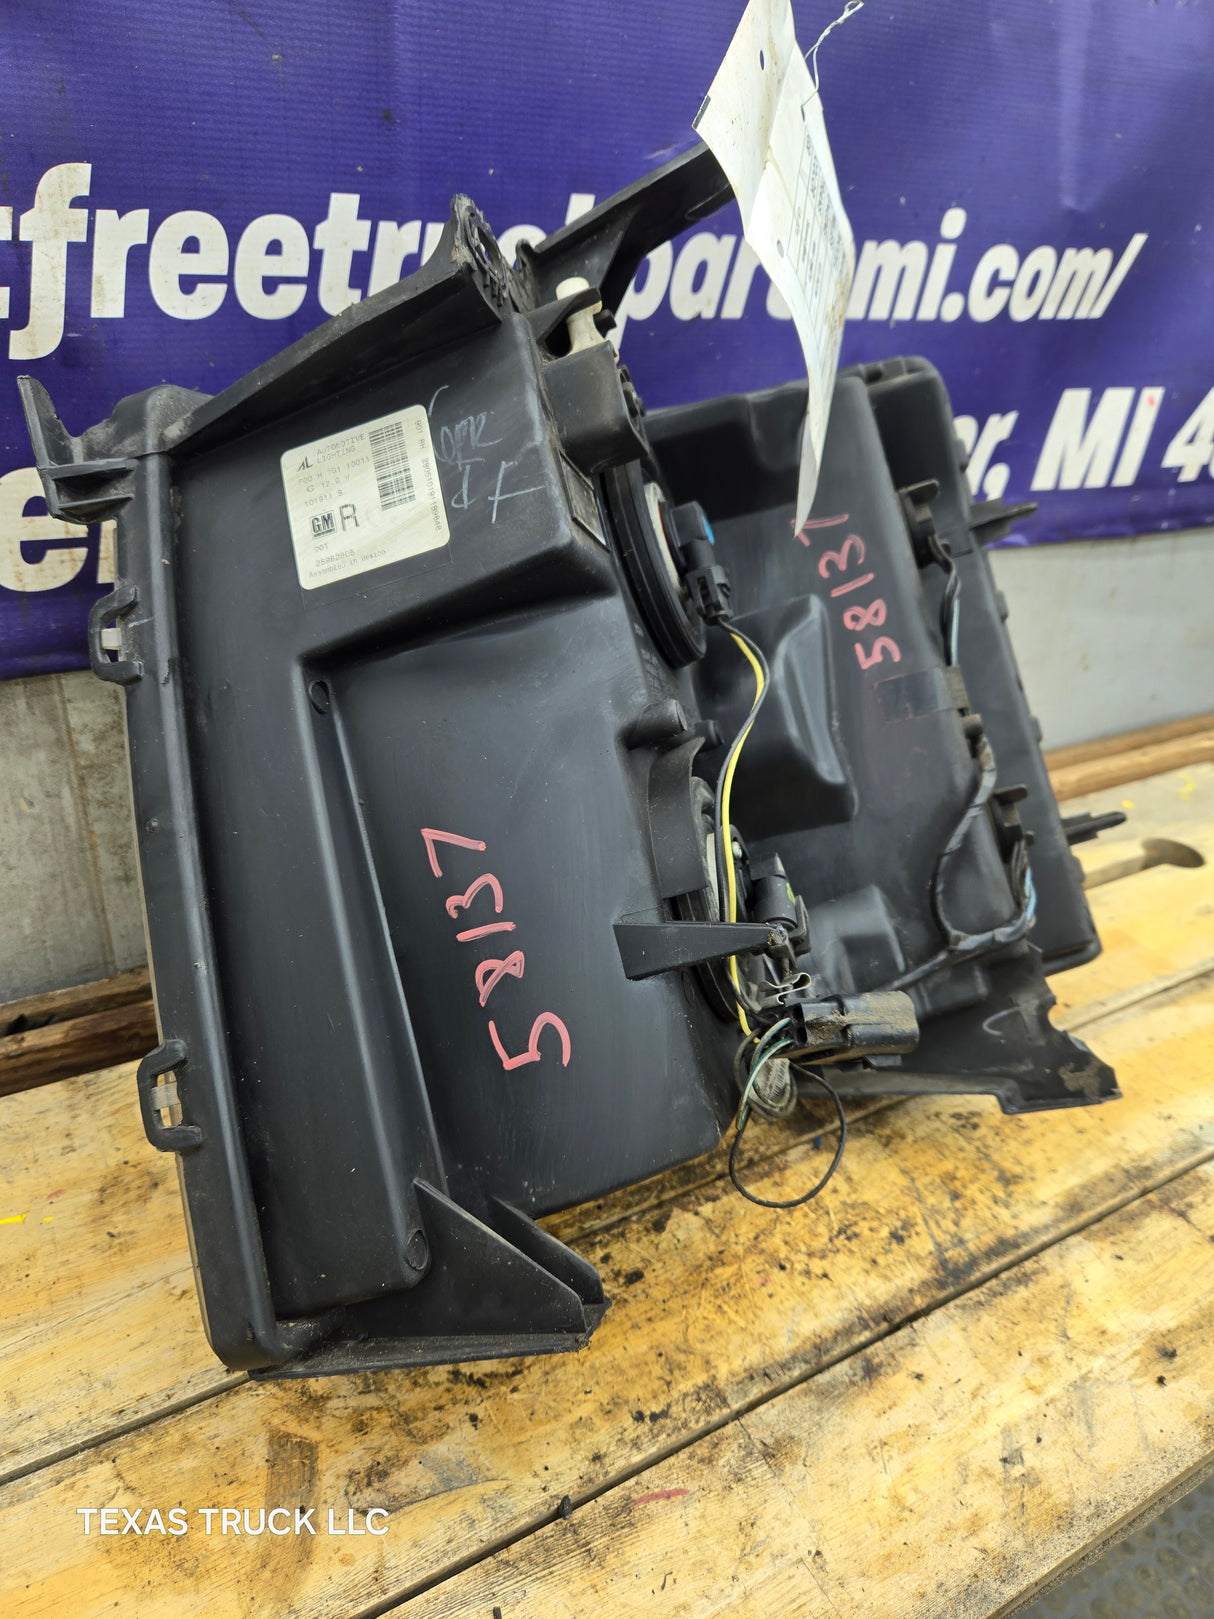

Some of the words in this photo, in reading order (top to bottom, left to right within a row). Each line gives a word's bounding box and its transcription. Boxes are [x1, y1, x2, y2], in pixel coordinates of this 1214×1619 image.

[414, 419, 423, 434] 901
[316, 432, 365, 455] AUTOMOTIVE
[1030, 386, 1166, 492] MI
[316, 444, 355, 464] LIGHTING
[310, 511, 334, 533] GM
[339, 500, 359, 532] R
[349, 557, 357, 565] in
[360, 548, 386, 562] Mexico
[421, 827, 571, 1071] 58137
